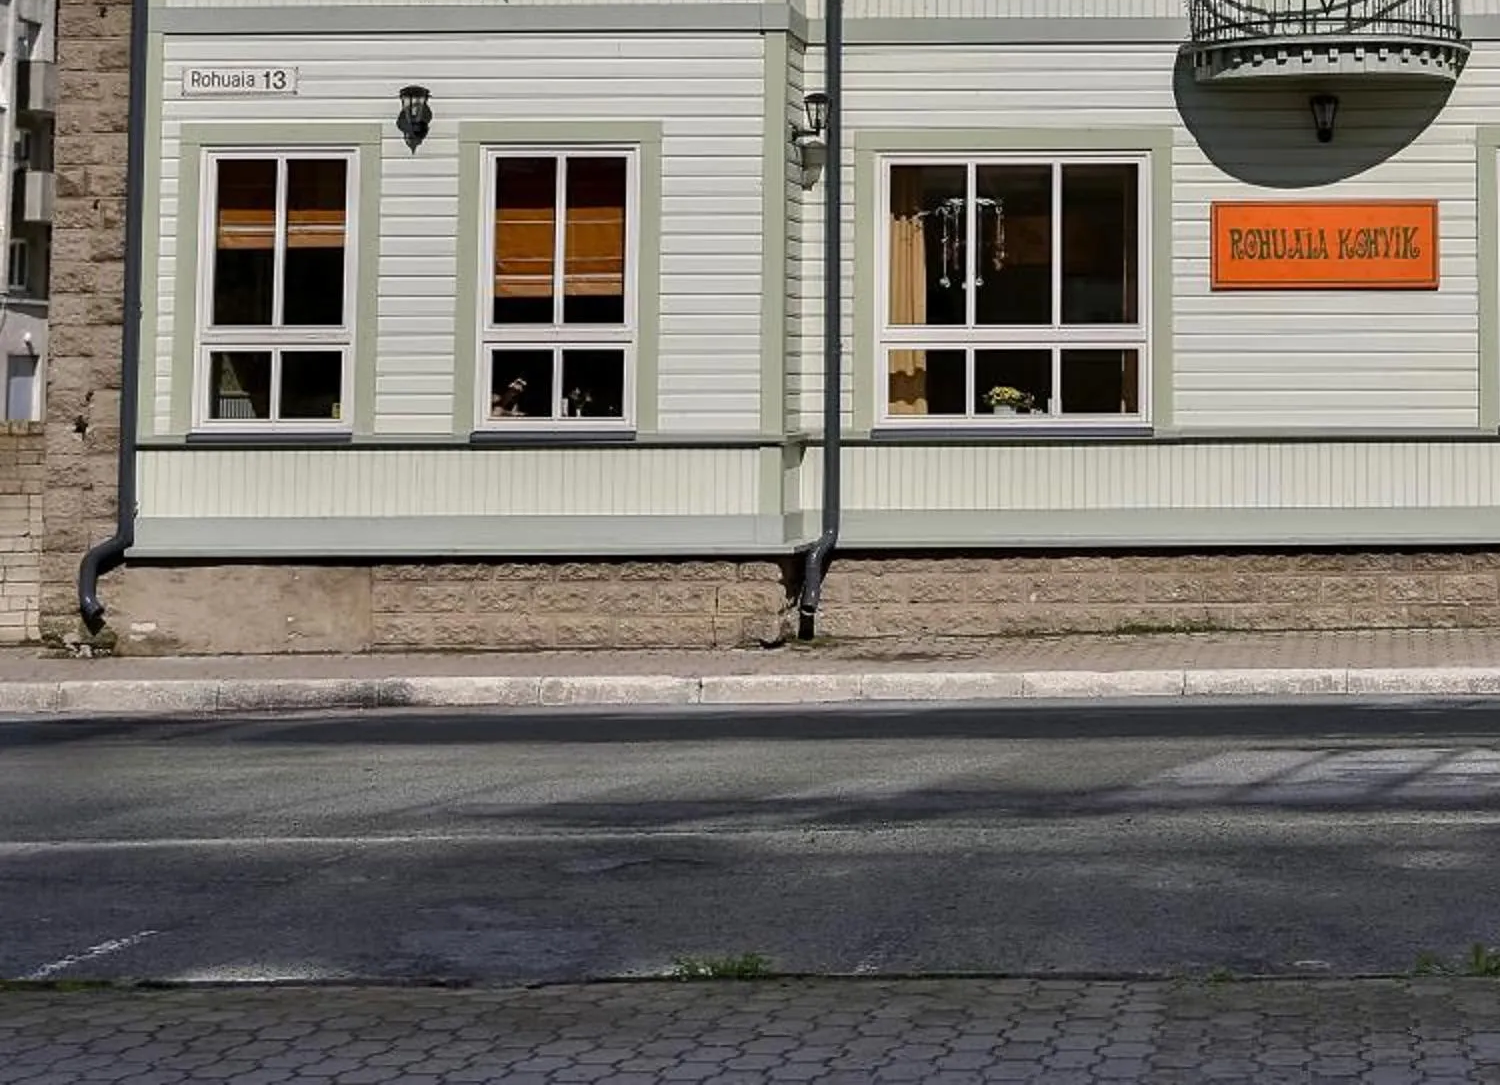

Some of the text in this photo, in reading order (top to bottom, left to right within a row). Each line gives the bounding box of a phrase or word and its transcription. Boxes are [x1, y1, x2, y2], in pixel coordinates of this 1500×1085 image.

[191, 70, 287, 90] Rohuaia 13
[1229, 226, 1421, 260] ROHUAIA KOHVIK
